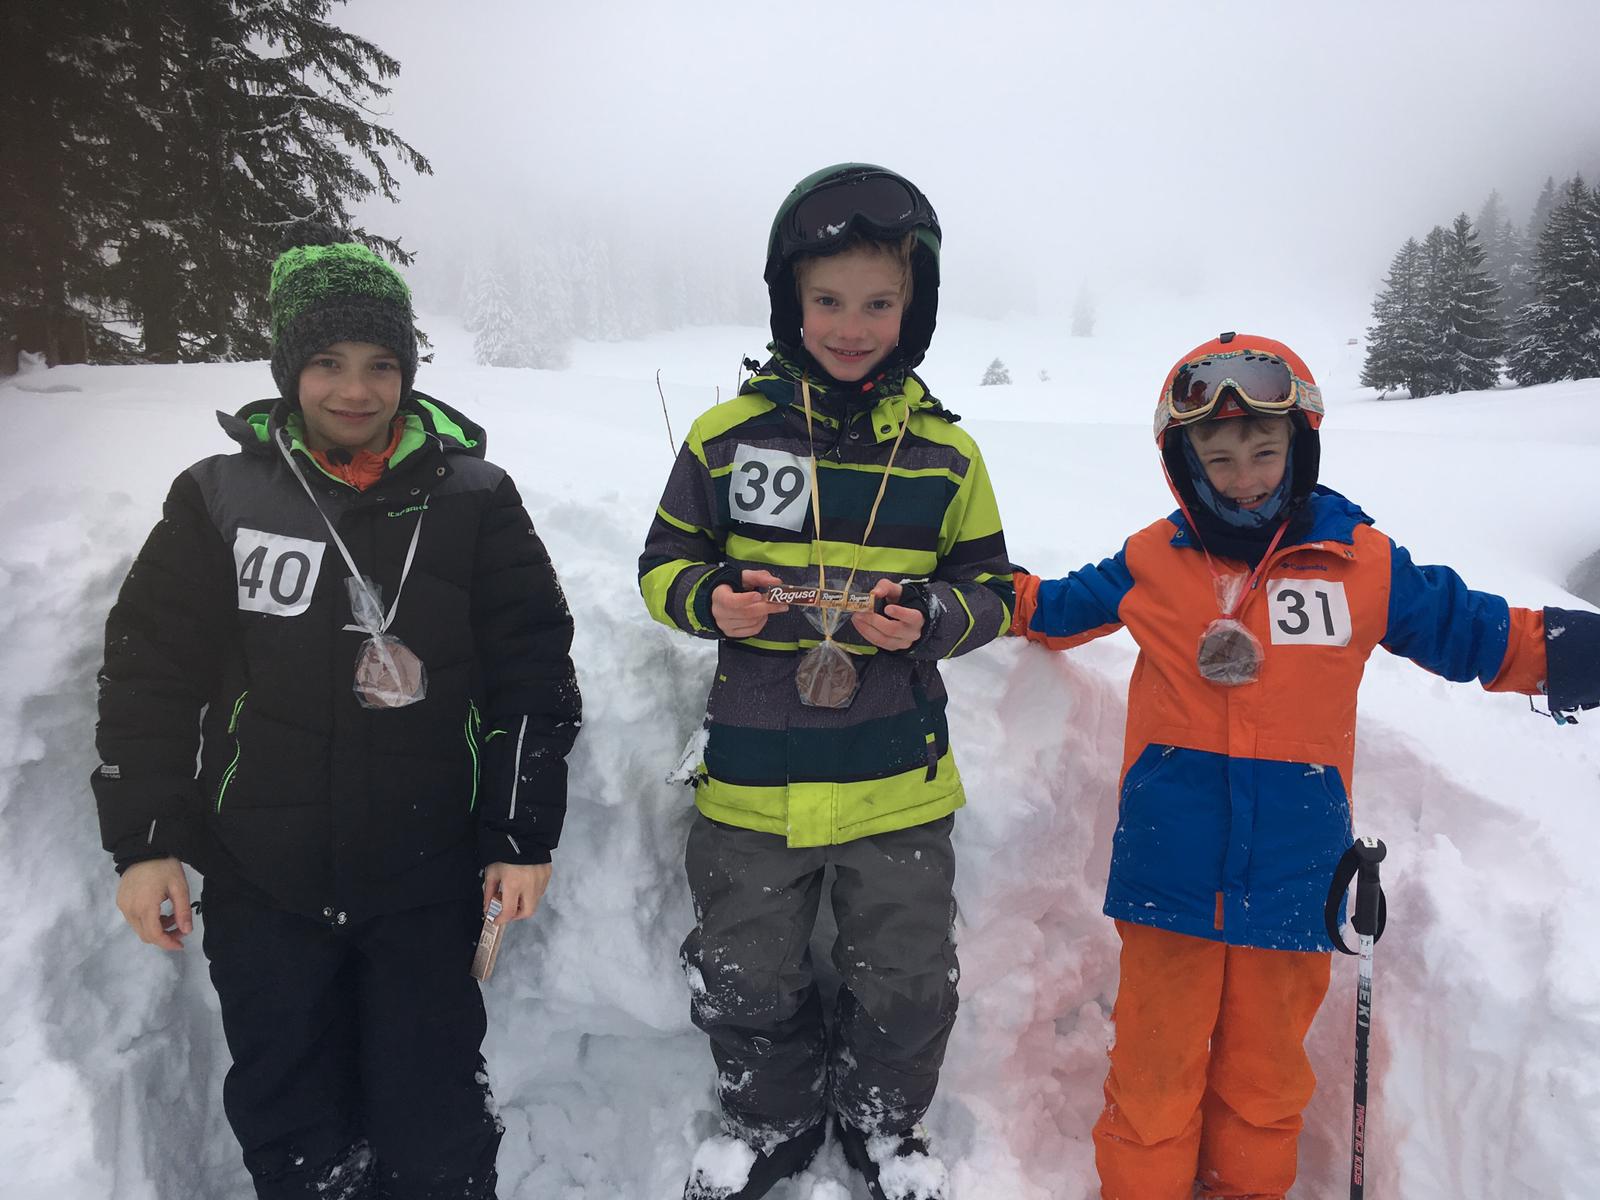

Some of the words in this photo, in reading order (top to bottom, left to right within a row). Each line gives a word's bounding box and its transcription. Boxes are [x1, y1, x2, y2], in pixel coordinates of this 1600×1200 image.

[734, 460, 805, 516] 39
[238, 545, 311, 606] 40
[769, 587, 816, 603] Ragusa
[1276, 589, 1335, 637] 31
[1355, 1103, 1365, 1154] RACING
[1354, 1154, 1363, 1187] KIDS
